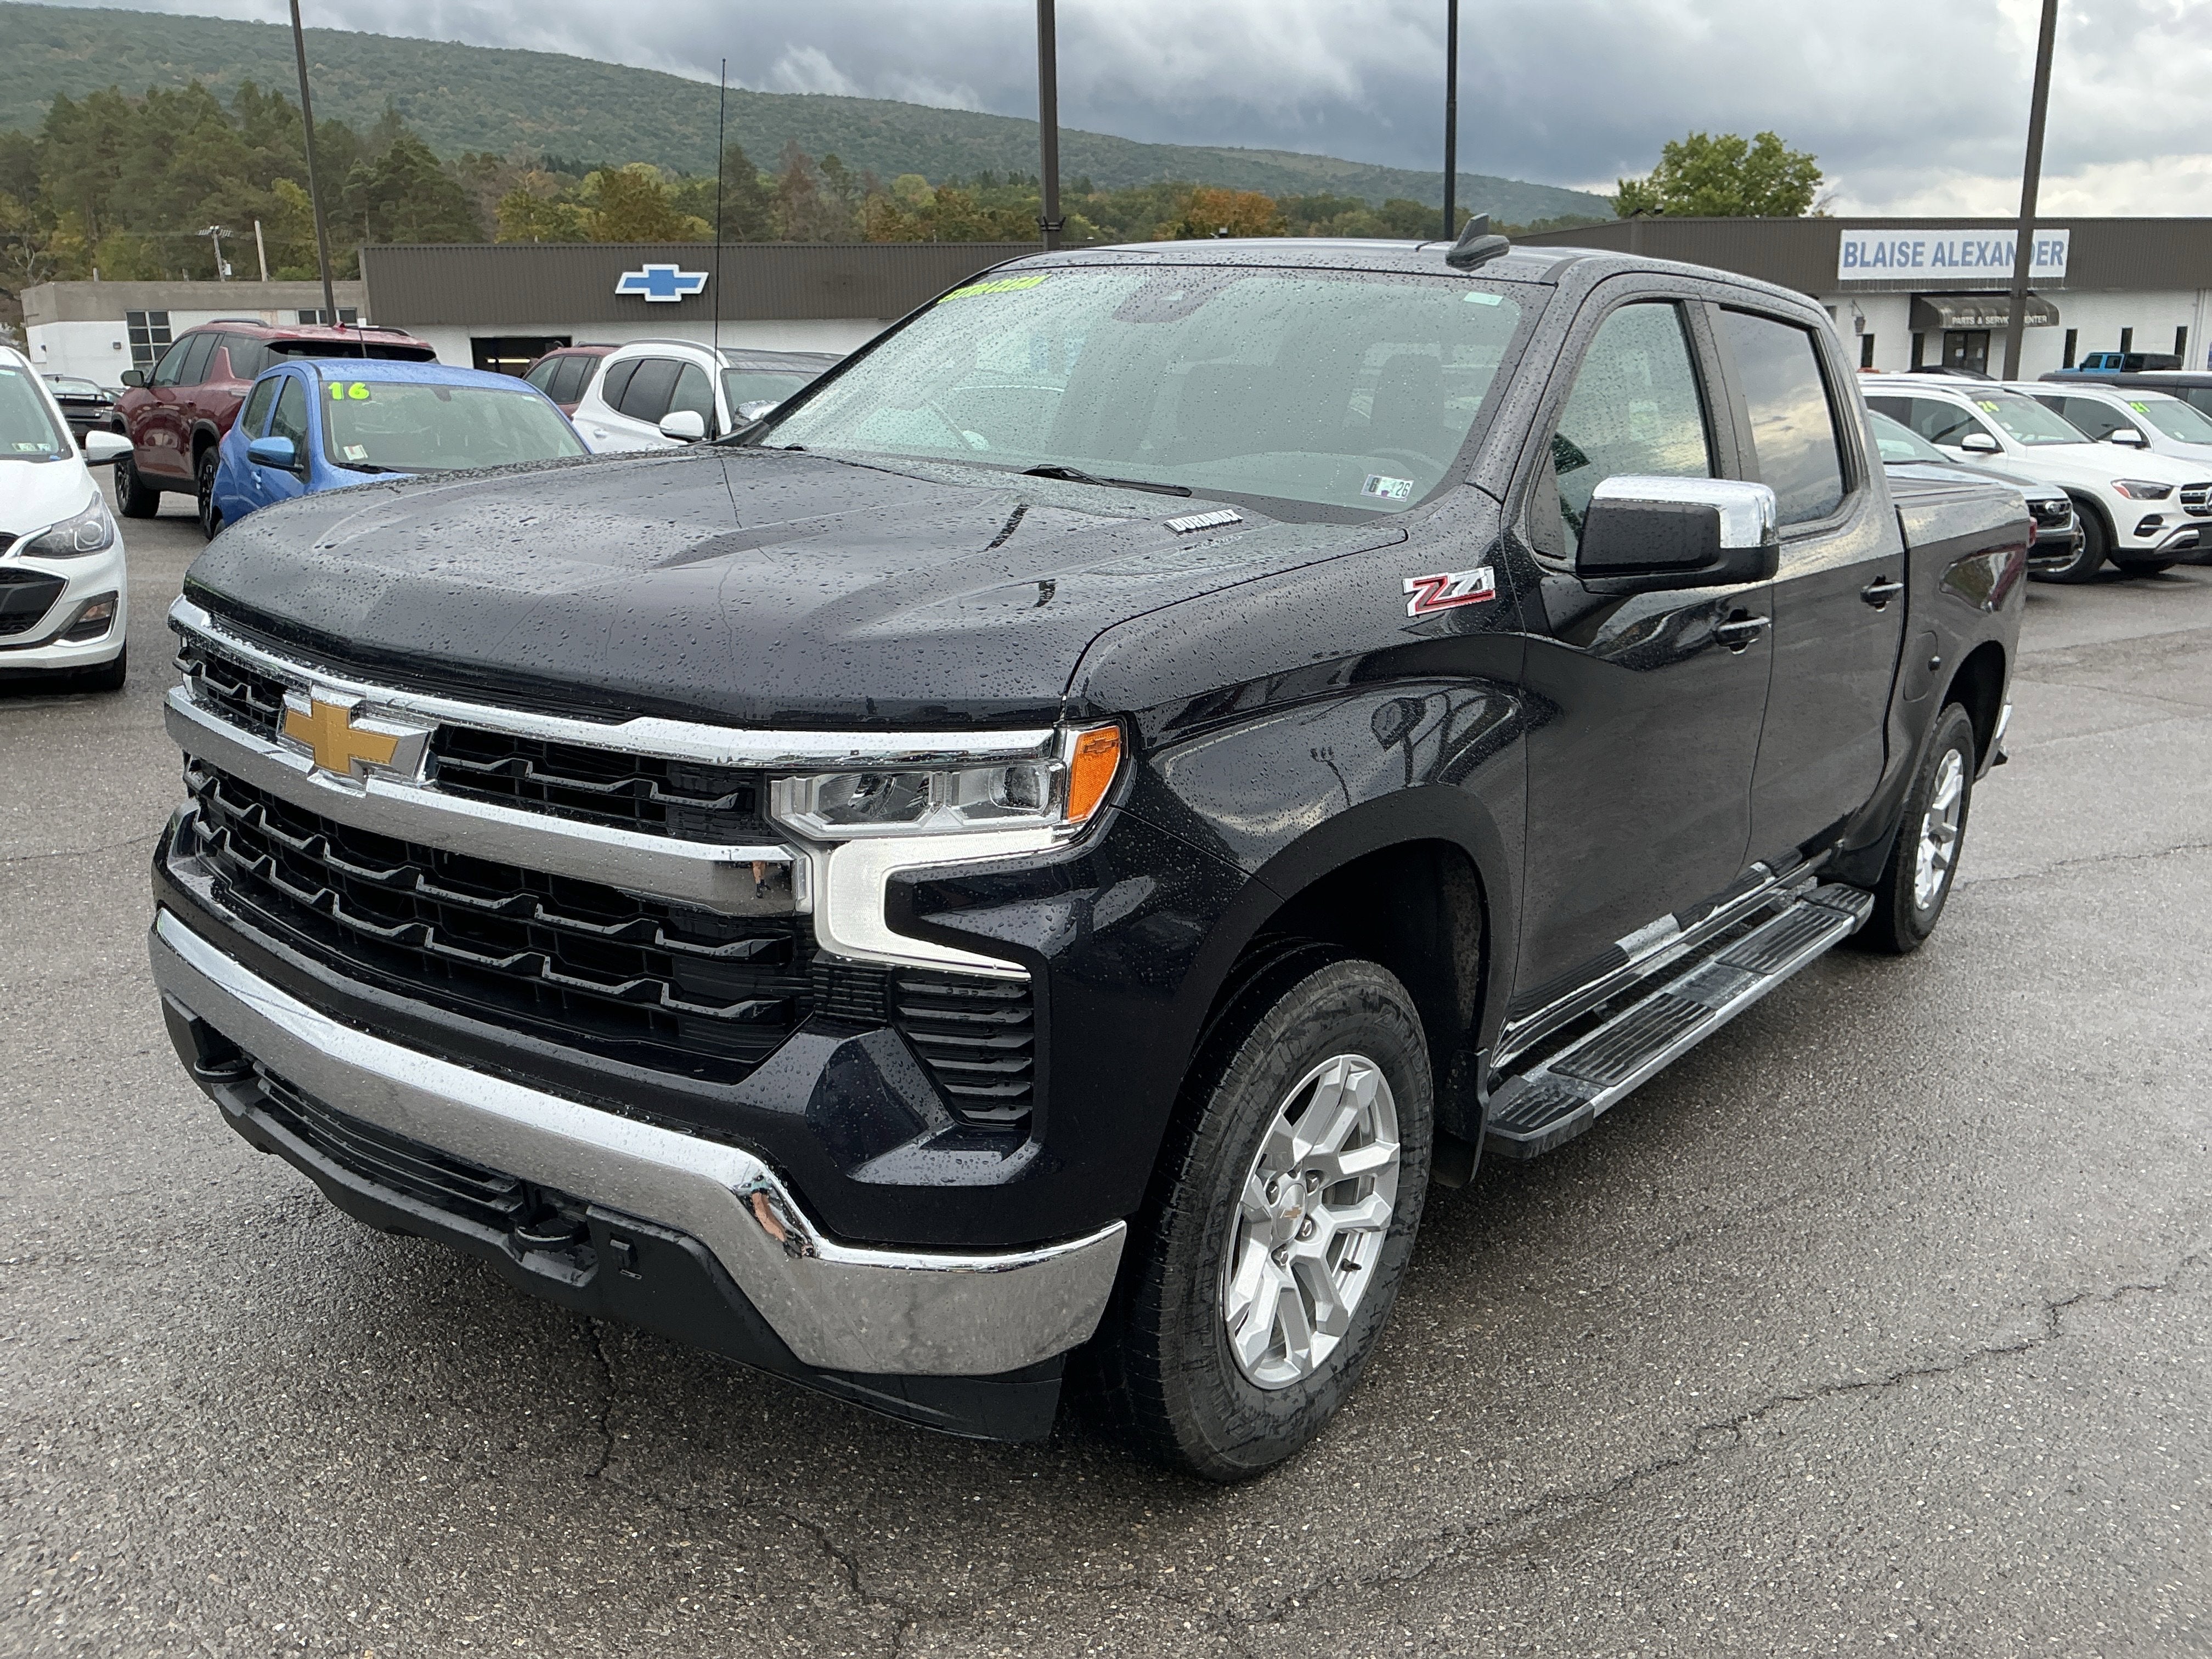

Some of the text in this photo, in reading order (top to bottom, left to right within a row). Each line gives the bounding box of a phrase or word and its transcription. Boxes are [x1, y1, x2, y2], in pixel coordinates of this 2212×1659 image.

[1843, 241, 1925, 268] BLAISE
[1952, 315, 1975, 325] PARTS
[1985, 315, 2010, 325] SERVIC
[2024, 314, 2047, 324] ENTER
[328, 382, 369, 400] 16
[1395, 481, 1410, 496] 26
[1163, 509, 1244, 533] DURAMAX
[1402, 566, 1496, 618] Z71
